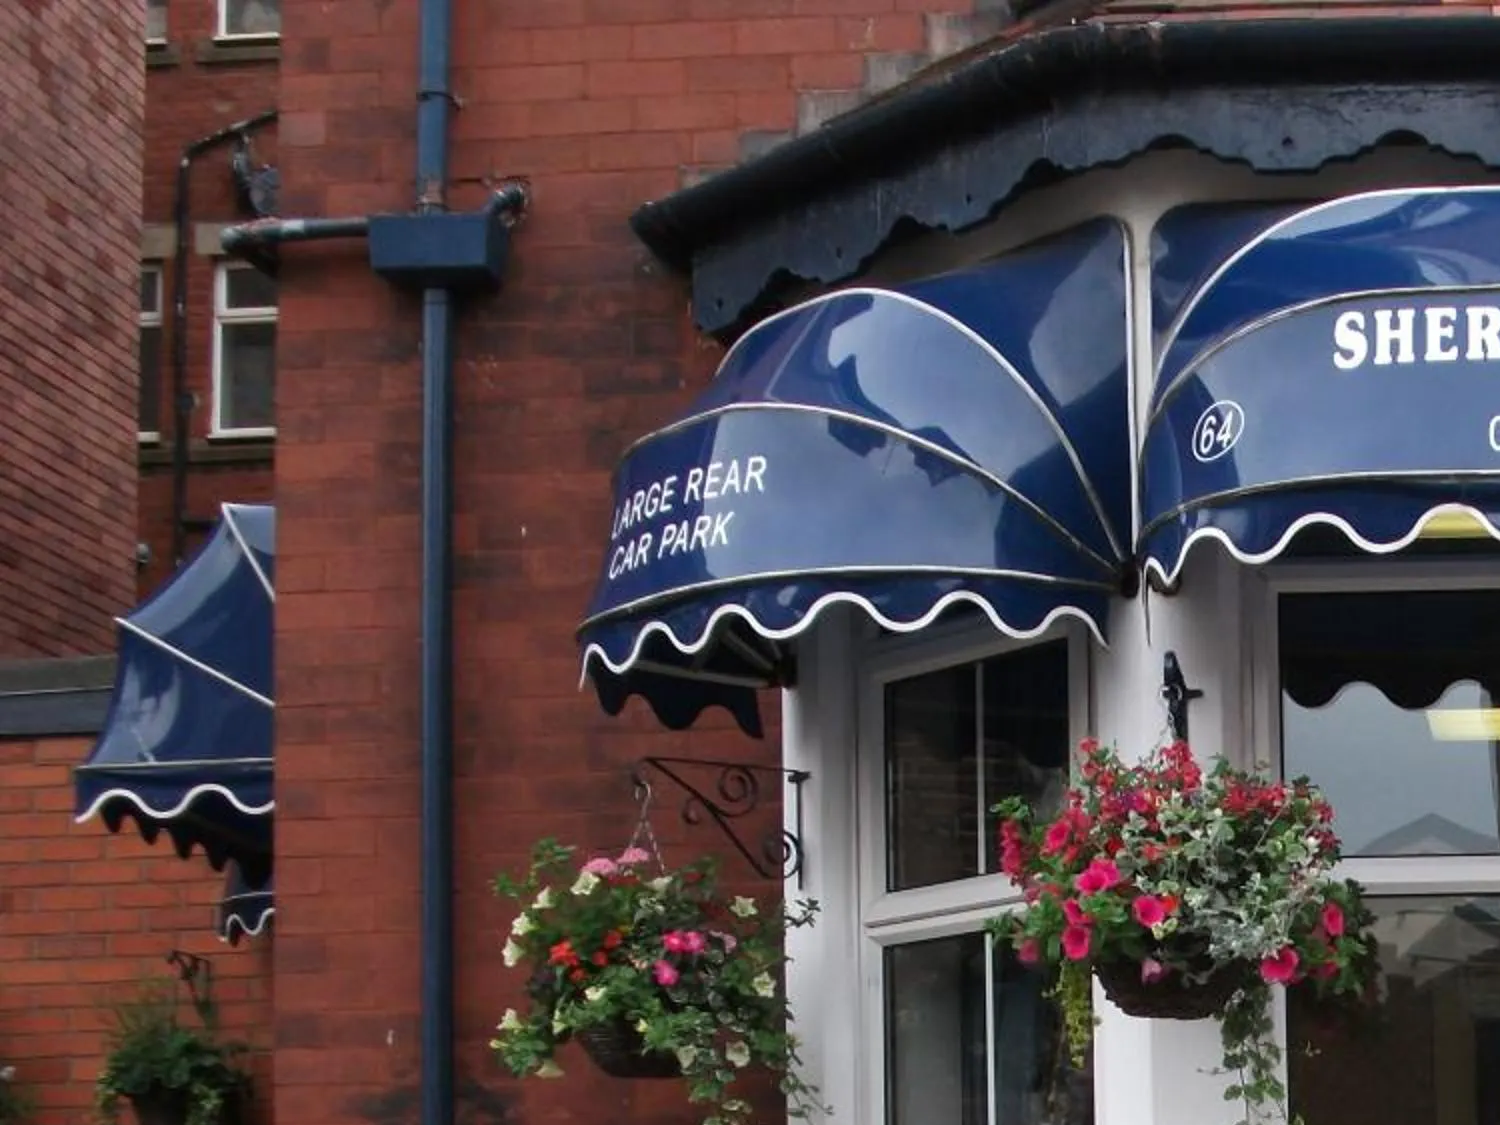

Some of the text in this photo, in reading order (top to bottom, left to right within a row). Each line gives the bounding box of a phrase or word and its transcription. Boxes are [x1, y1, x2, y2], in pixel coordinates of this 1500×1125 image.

[1201, 410, 1234, 455] 64
[611, 455, 767, 540] LARGE REAR
[608, 511, 735, 580] CAR PARK
